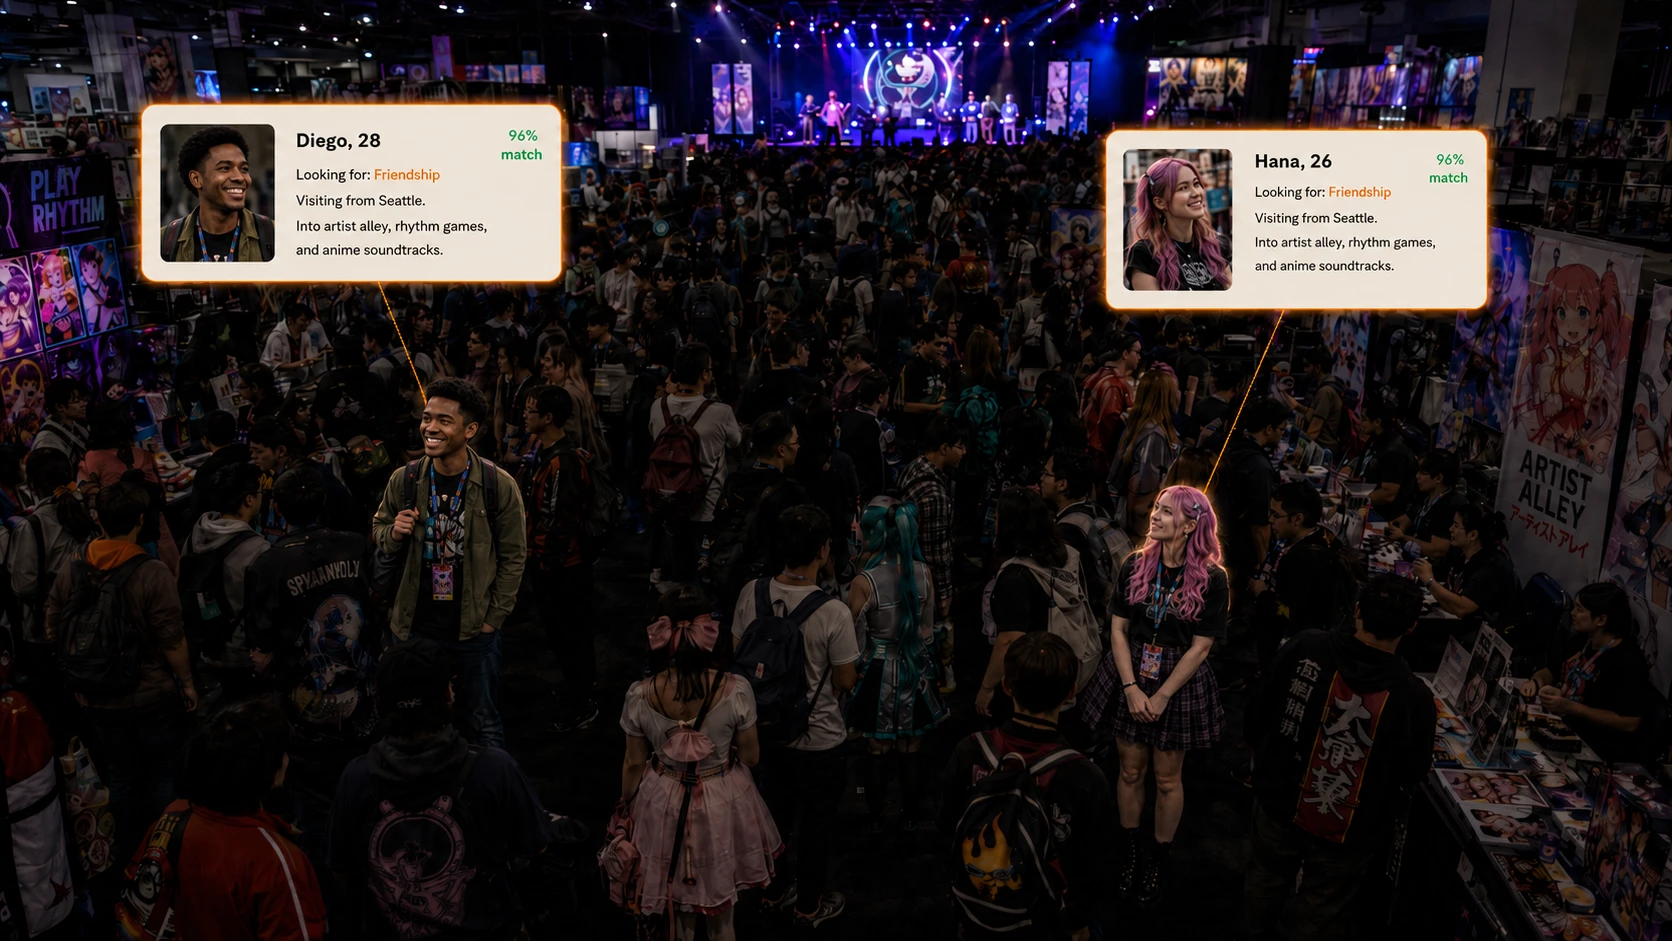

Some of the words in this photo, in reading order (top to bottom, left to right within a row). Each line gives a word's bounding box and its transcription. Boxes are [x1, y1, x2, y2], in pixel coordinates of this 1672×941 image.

[30, 165, 82, 202] PLAY
[32, 195, 105, 233] RHYTHM
[1519, 449, 1593, 501] ARTIST
[1518, 479, 1586, 530] ALLEY
